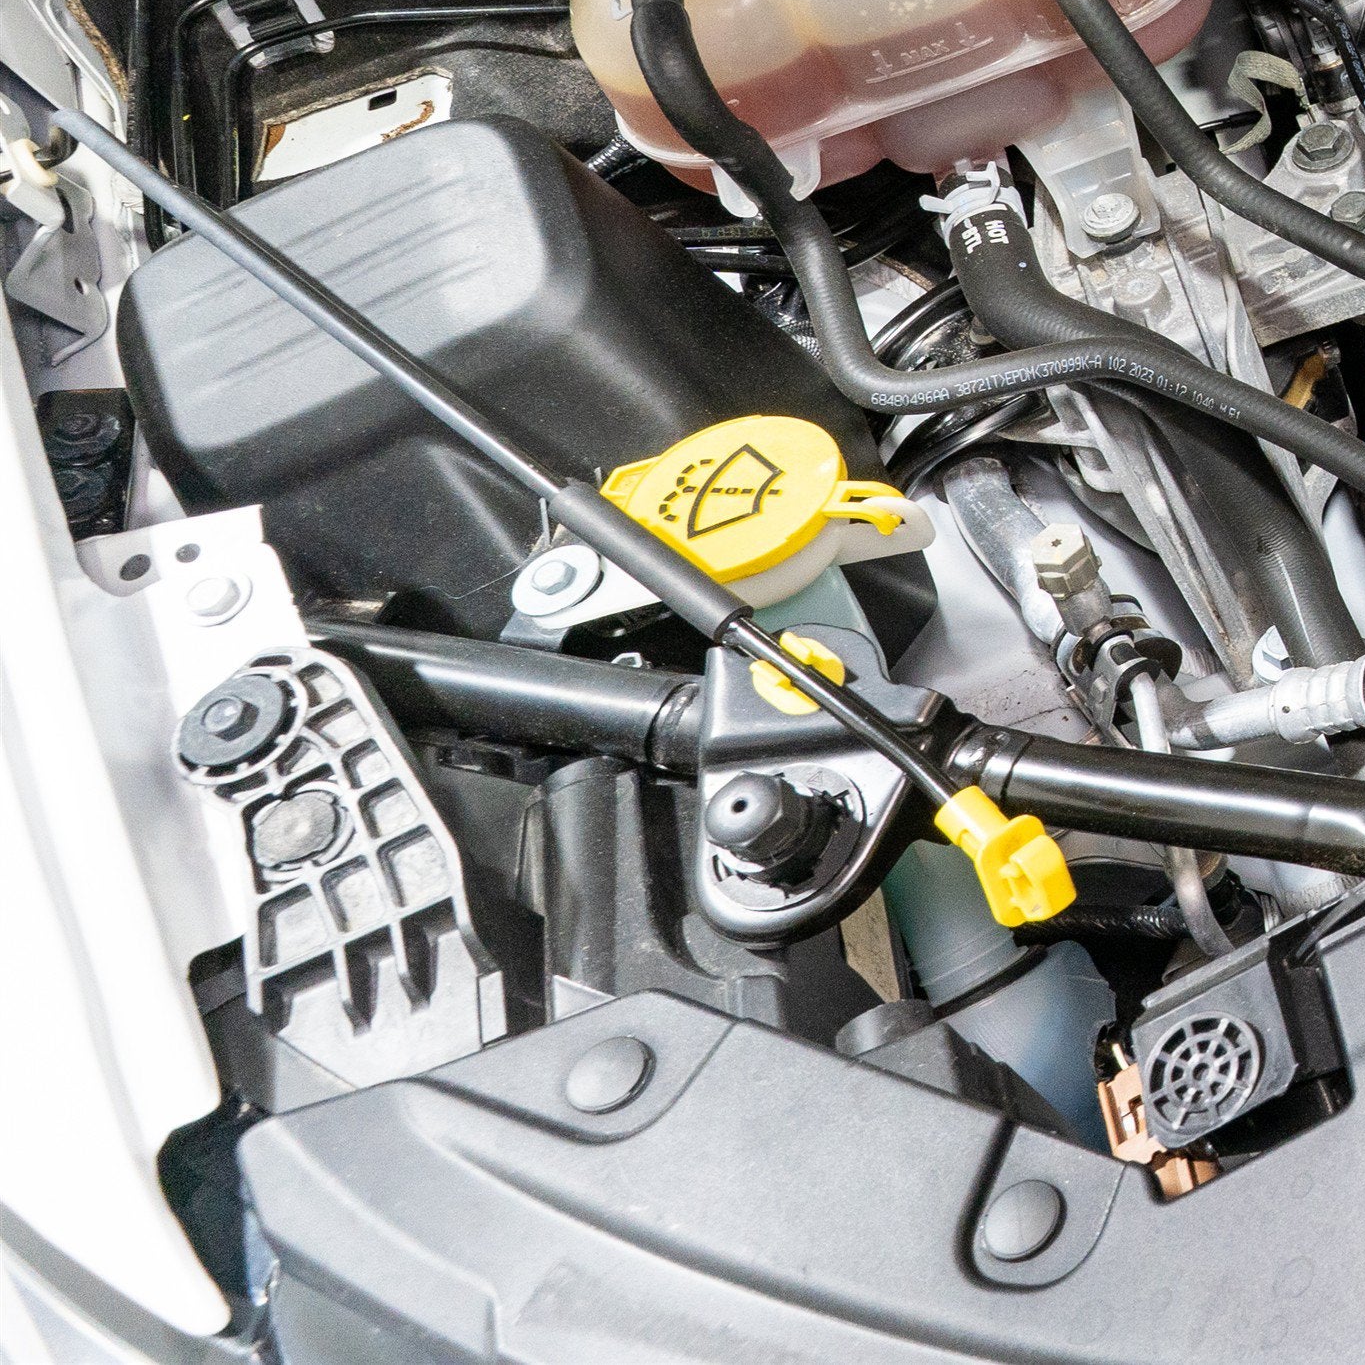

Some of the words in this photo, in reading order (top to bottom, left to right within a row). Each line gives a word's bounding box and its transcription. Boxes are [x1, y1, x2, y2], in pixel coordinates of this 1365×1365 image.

[900, 40, 950, 64] MAX
[984, 219, 1008, 245] HOT
[871, 387, 949, 408] 68480496AA
[1107, 356, 1126, 372] 102
[1129, 362, 1155, 383] 2023
